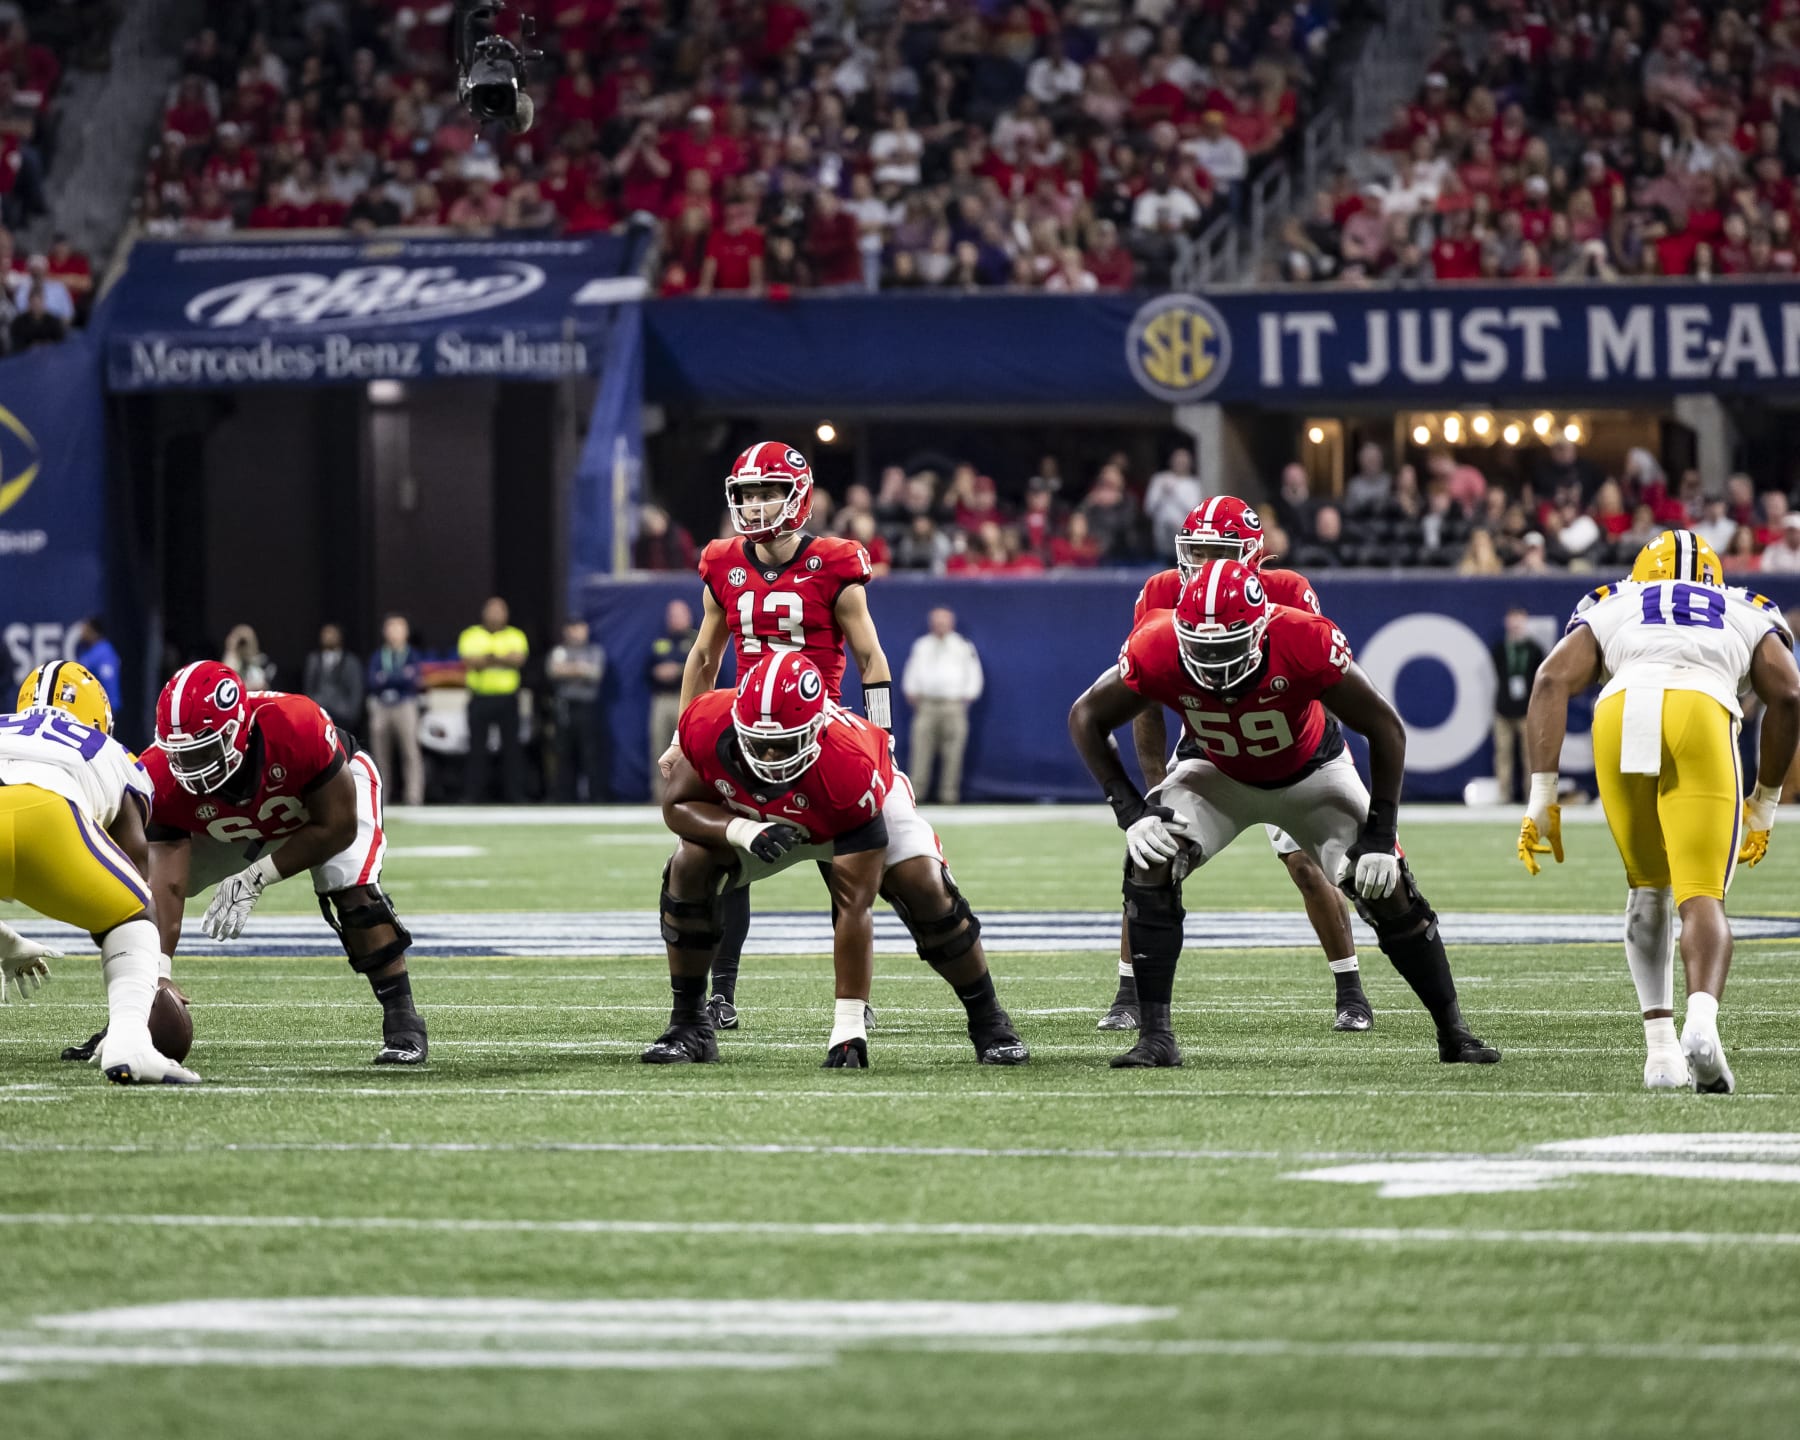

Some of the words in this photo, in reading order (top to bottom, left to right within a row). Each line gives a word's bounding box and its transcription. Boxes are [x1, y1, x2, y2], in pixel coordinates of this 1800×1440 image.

[131, 334, 421, 384] Mercedes-Benz
[435, 330, 588, 376] Stadium
[1259, 311, 1338, 386] IT
[1348, 307, 1561, 383] JUST
[729, 568, 746, 586] SEC
[737, 592, 805, 652] 13
[1641, 584, 1725, 629] 18
[1185, 709, 1294, 757] 59
[858, 769, 887, 817] 77
[206, 795, 311, 842] 63
